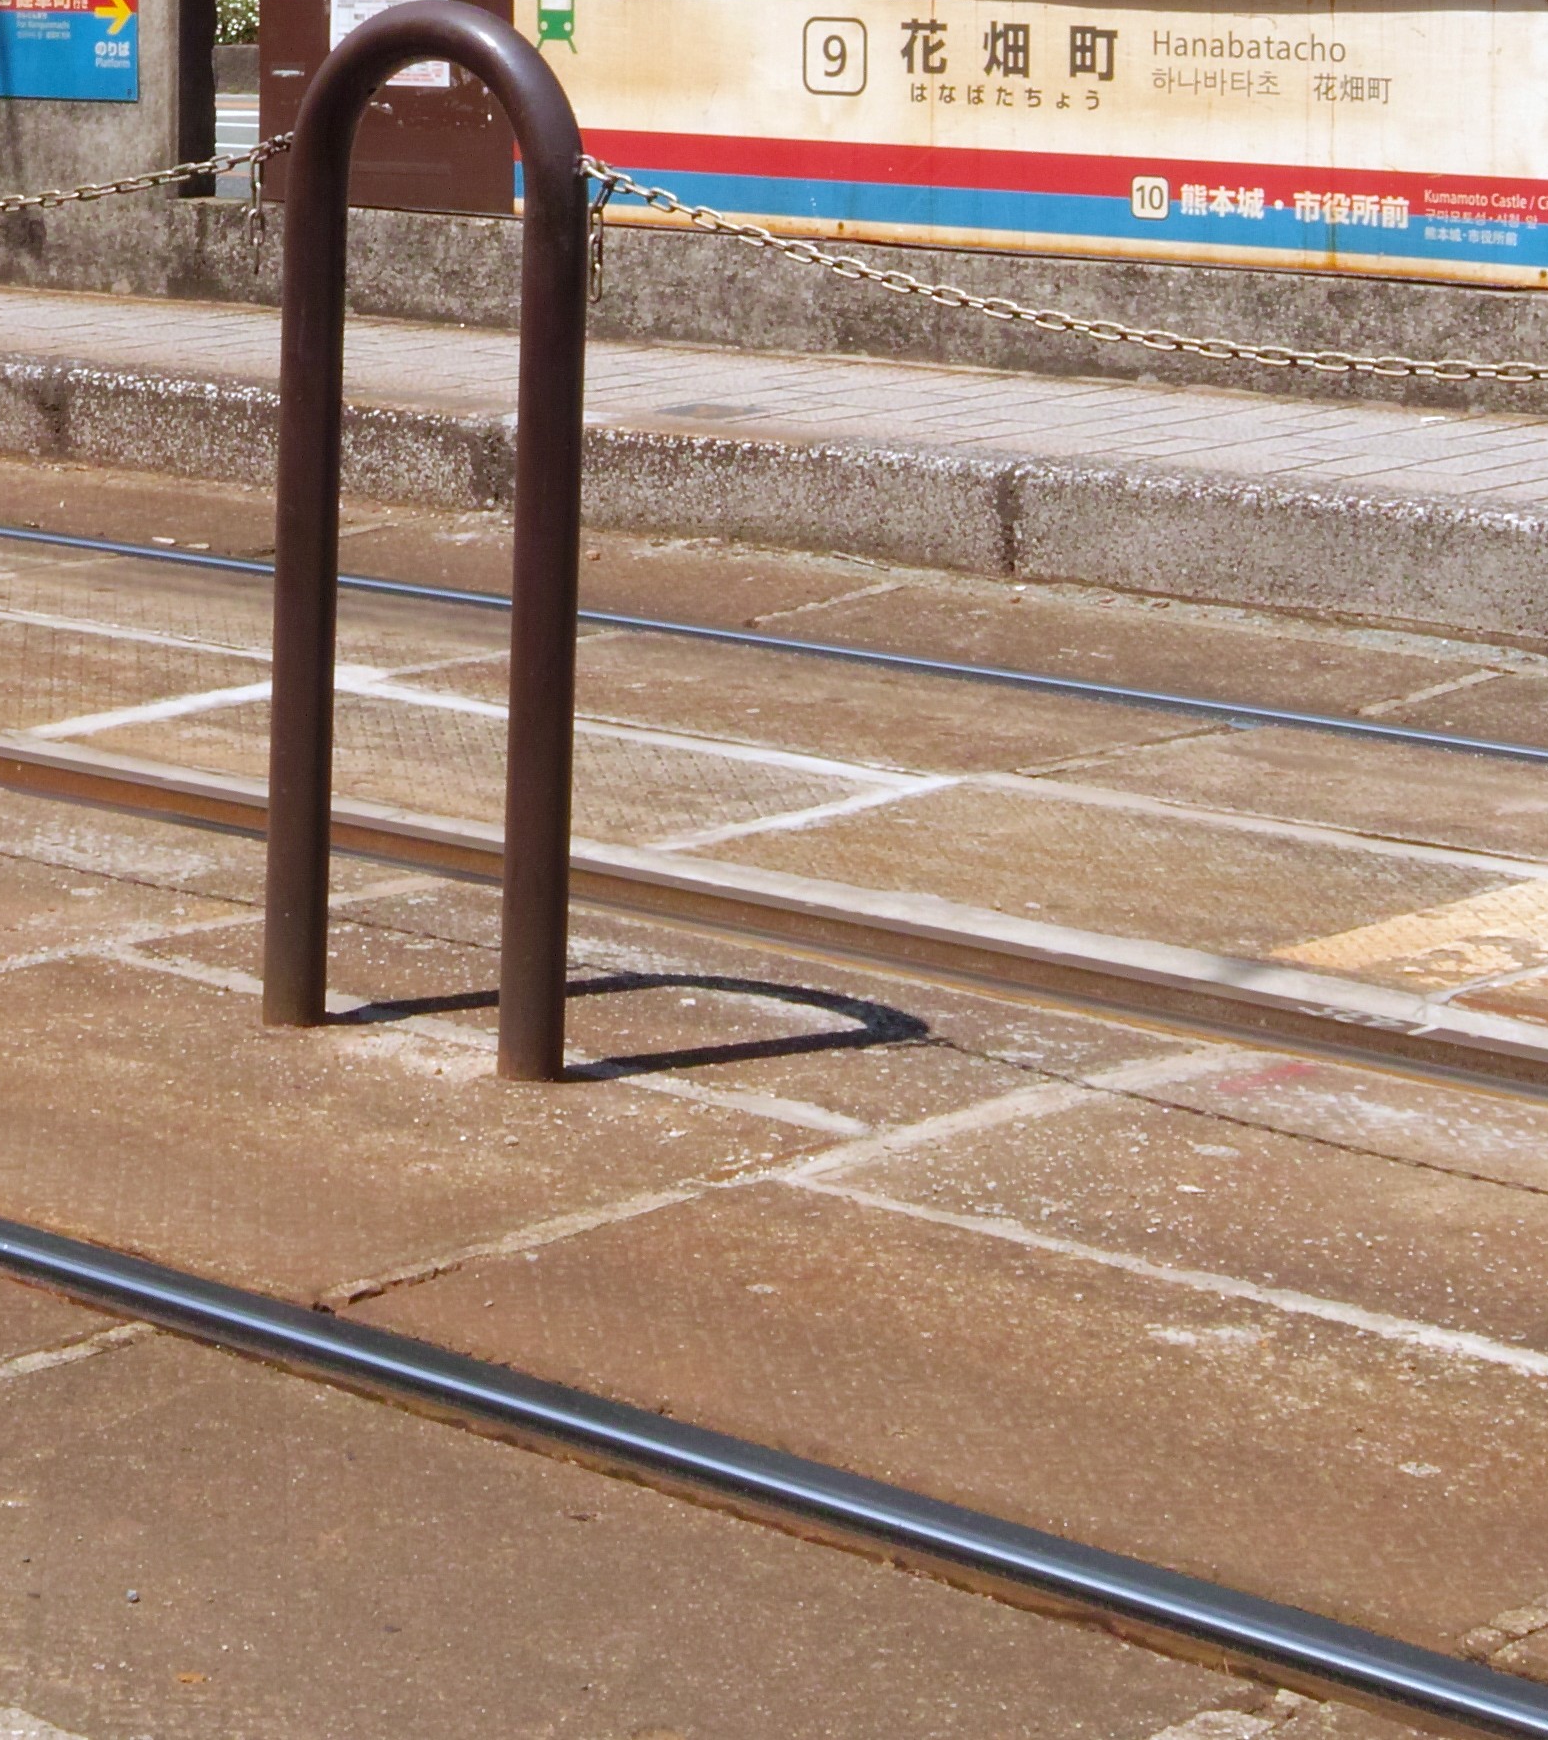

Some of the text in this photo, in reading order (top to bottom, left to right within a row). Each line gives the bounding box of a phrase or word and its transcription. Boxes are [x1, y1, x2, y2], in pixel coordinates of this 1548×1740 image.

[95, 41, 130, 57] のりば
[823, 34, 848, 78] 9
[900, 18, 1118, 82] 花畑町
[1153, 29, 1347, 63] Hanabatacho
[909, 82, 1102, 110] はなばたちょう
[1151, 66, 1281, 98] 하나바타초
[1313, 73, 1393, 105] 花畑町
[1134, 183, 1411, 230] 10 熊本城・市役所前
[1424, 189, 1489, 207] Kumamoto
[1491, 193, 1527, 210] Castle
[1529, 196, 1536, 211] /
